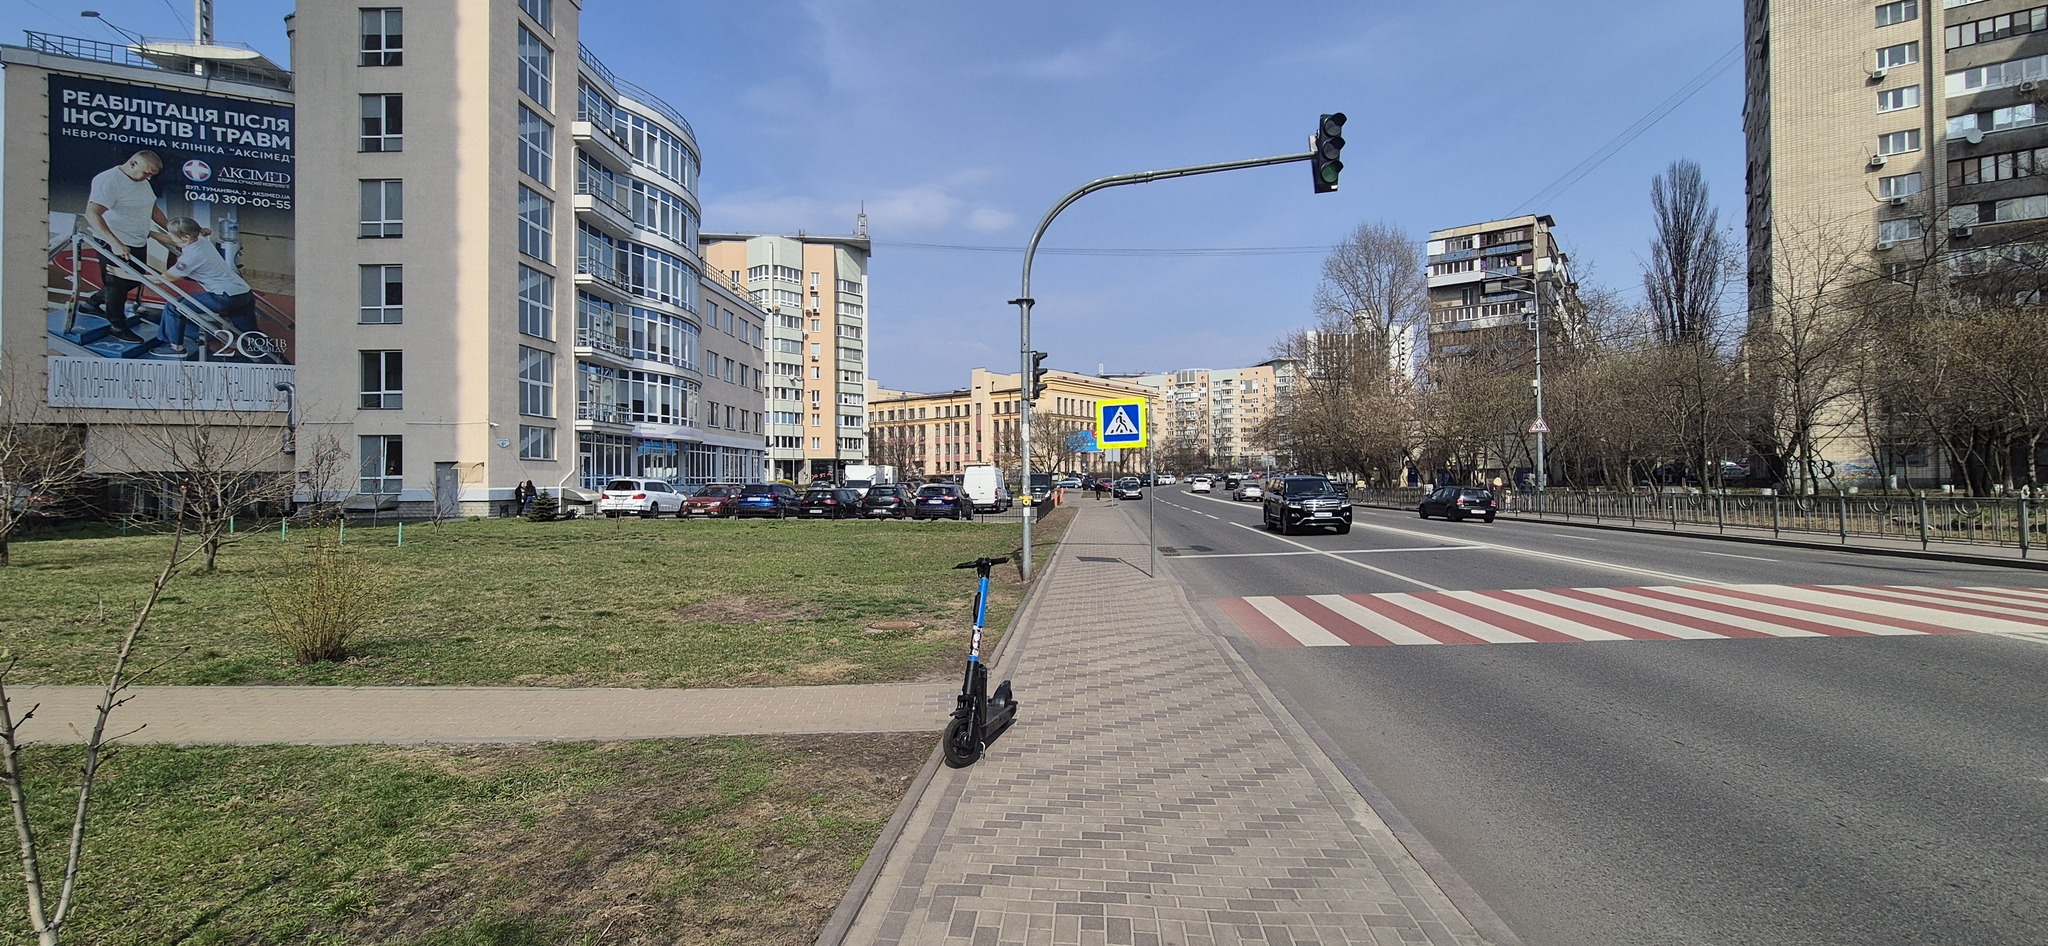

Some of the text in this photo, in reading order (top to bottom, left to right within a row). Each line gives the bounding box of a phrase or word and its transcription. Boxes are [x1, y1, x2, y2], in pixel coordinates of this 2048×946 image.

[62, 89, 290, 133] РЕАБІЛІТАЦІЯ ПІСЛЯ
[62, 127, 168, 148] НЕВРОЛОГІЧНА
[171, 140, 225, 155] КЛІНІКА
[63, 107, 291, 151] ІНСУЛЬТІВ І ТРАВМ
[184, 190, 292, 210] (044) 390-00-55
[252, 191, 291, 200] AKSIMED.UA
[247, 337, 288, 348] РОКІВ
